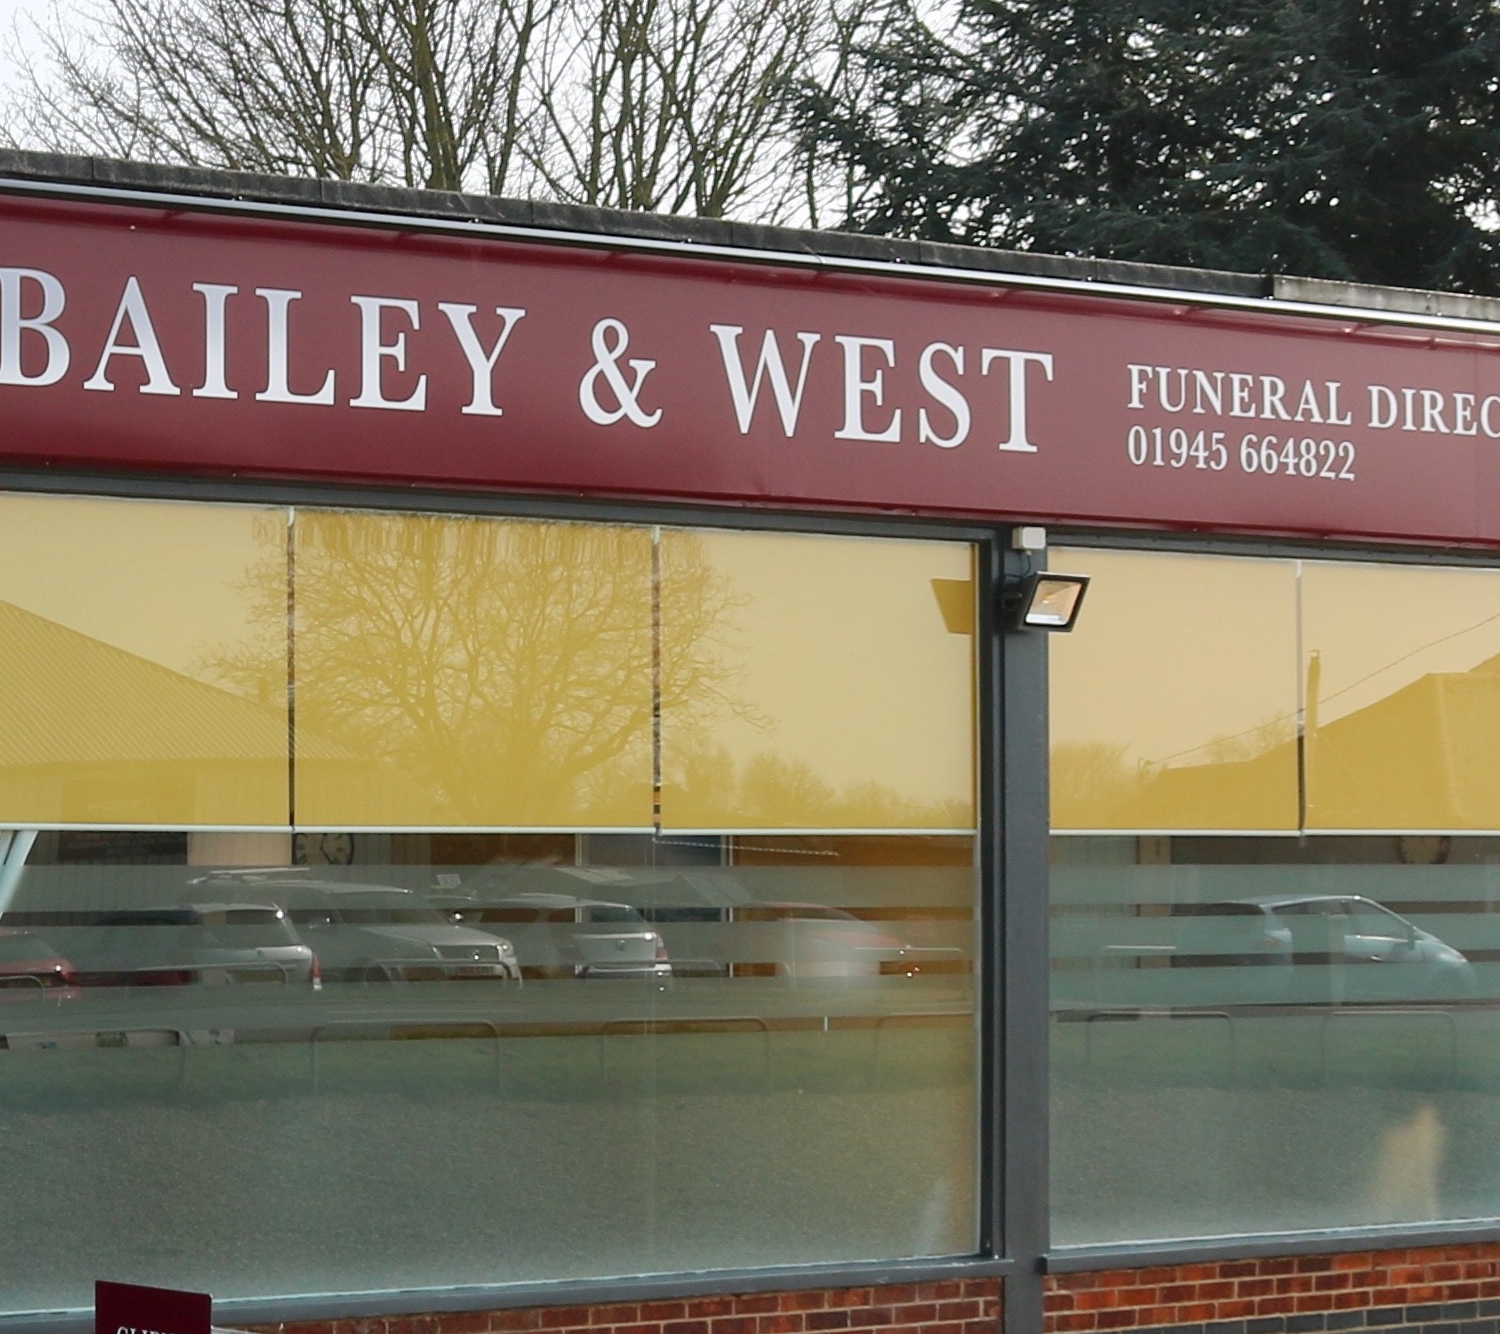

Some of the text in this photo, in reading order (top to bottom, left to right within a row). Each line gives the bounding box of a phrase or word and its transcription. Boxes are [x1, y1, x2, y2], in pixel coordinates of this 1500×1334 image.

[579, 318, 664, 428] &
[709, 324, 1054, 454] WEST
[1126, 363, 1353, 428] FUNERAL
[1127, 424, 1356, 482] 01945 664822
